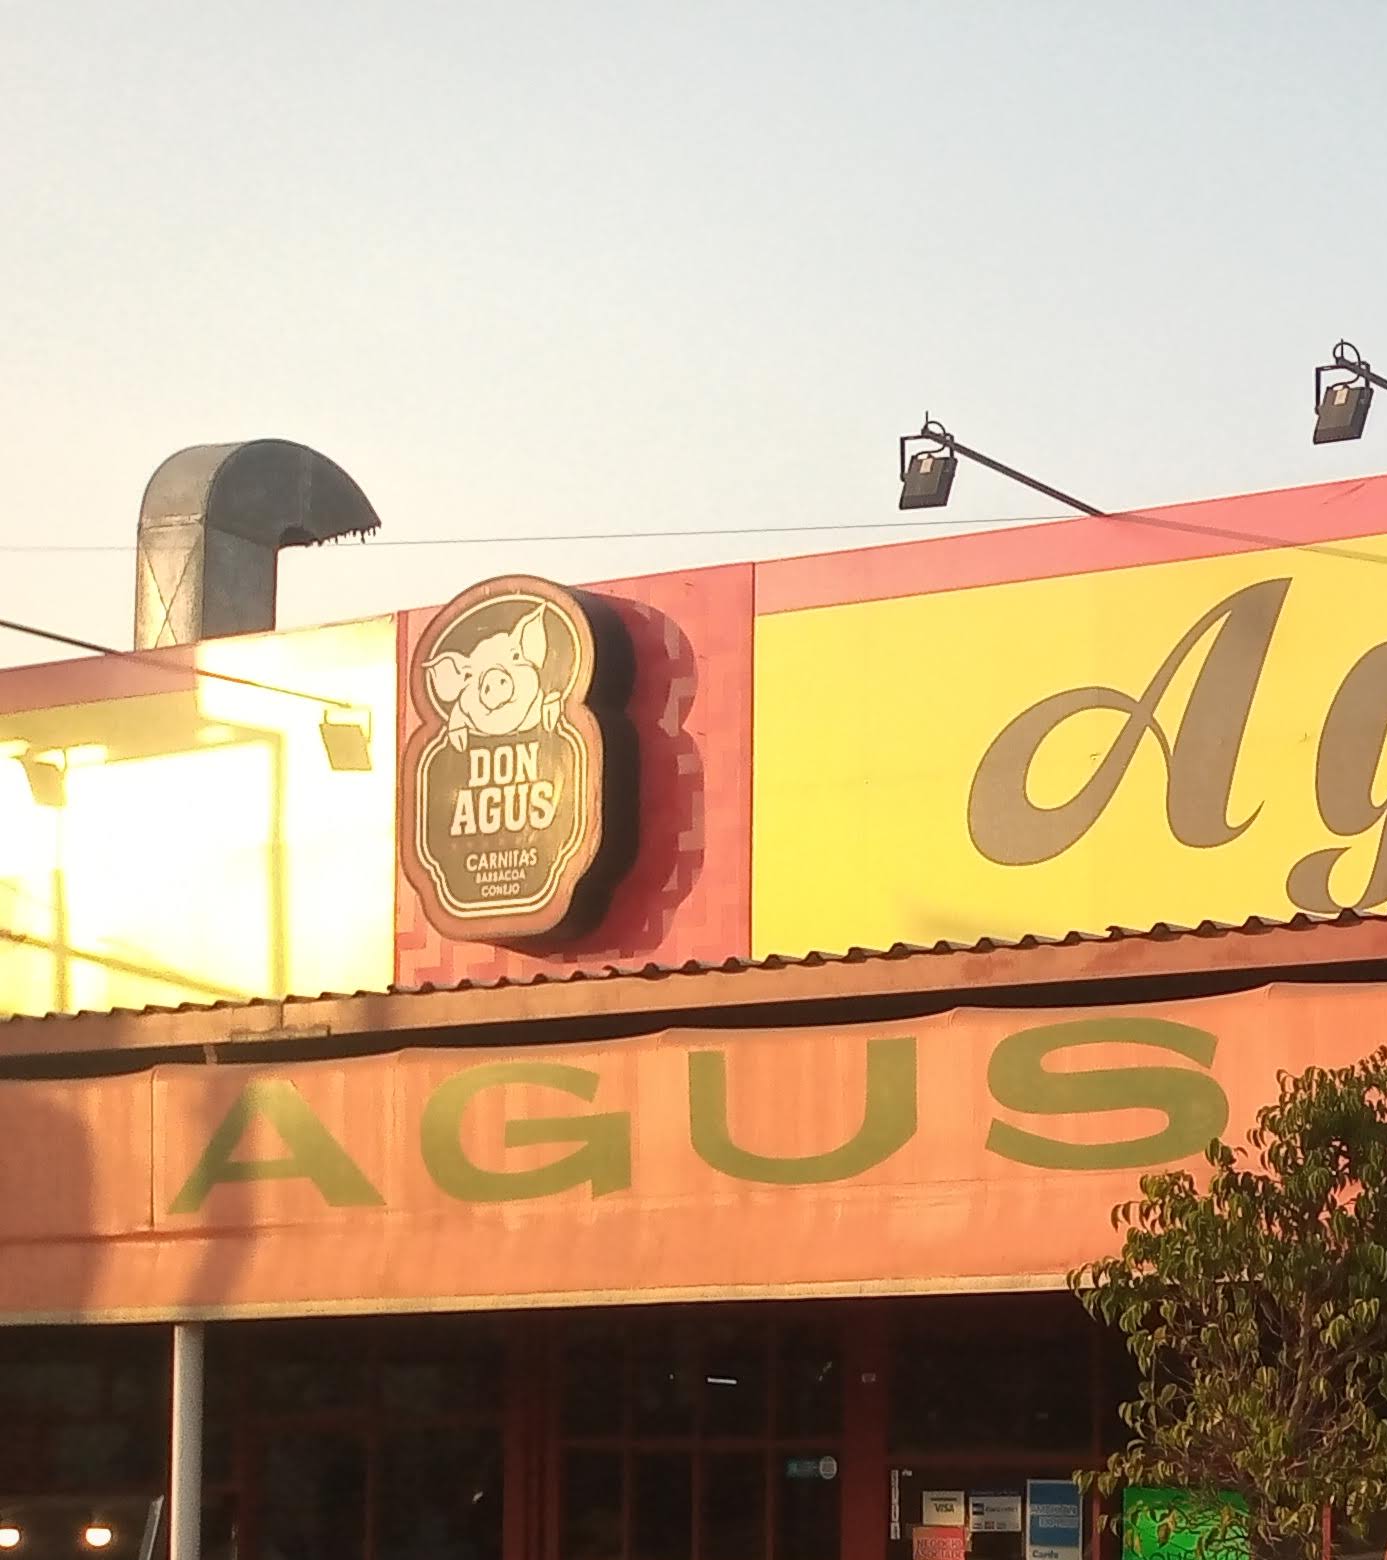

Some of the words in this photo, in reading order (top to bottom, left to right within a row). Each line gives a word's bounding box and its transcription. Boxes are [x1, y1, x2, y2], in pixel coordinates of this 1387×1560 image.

[469, 741, 539, 787] DON
[451, 780, 554, 836] AGUS
[466, 848, 537, 871] CARNITAS
[168, 1016, 1229, 1214] AGUS
[934, 1503, 955, 1513] VISA
[1032, 1549, 1058, 1560] Cards
